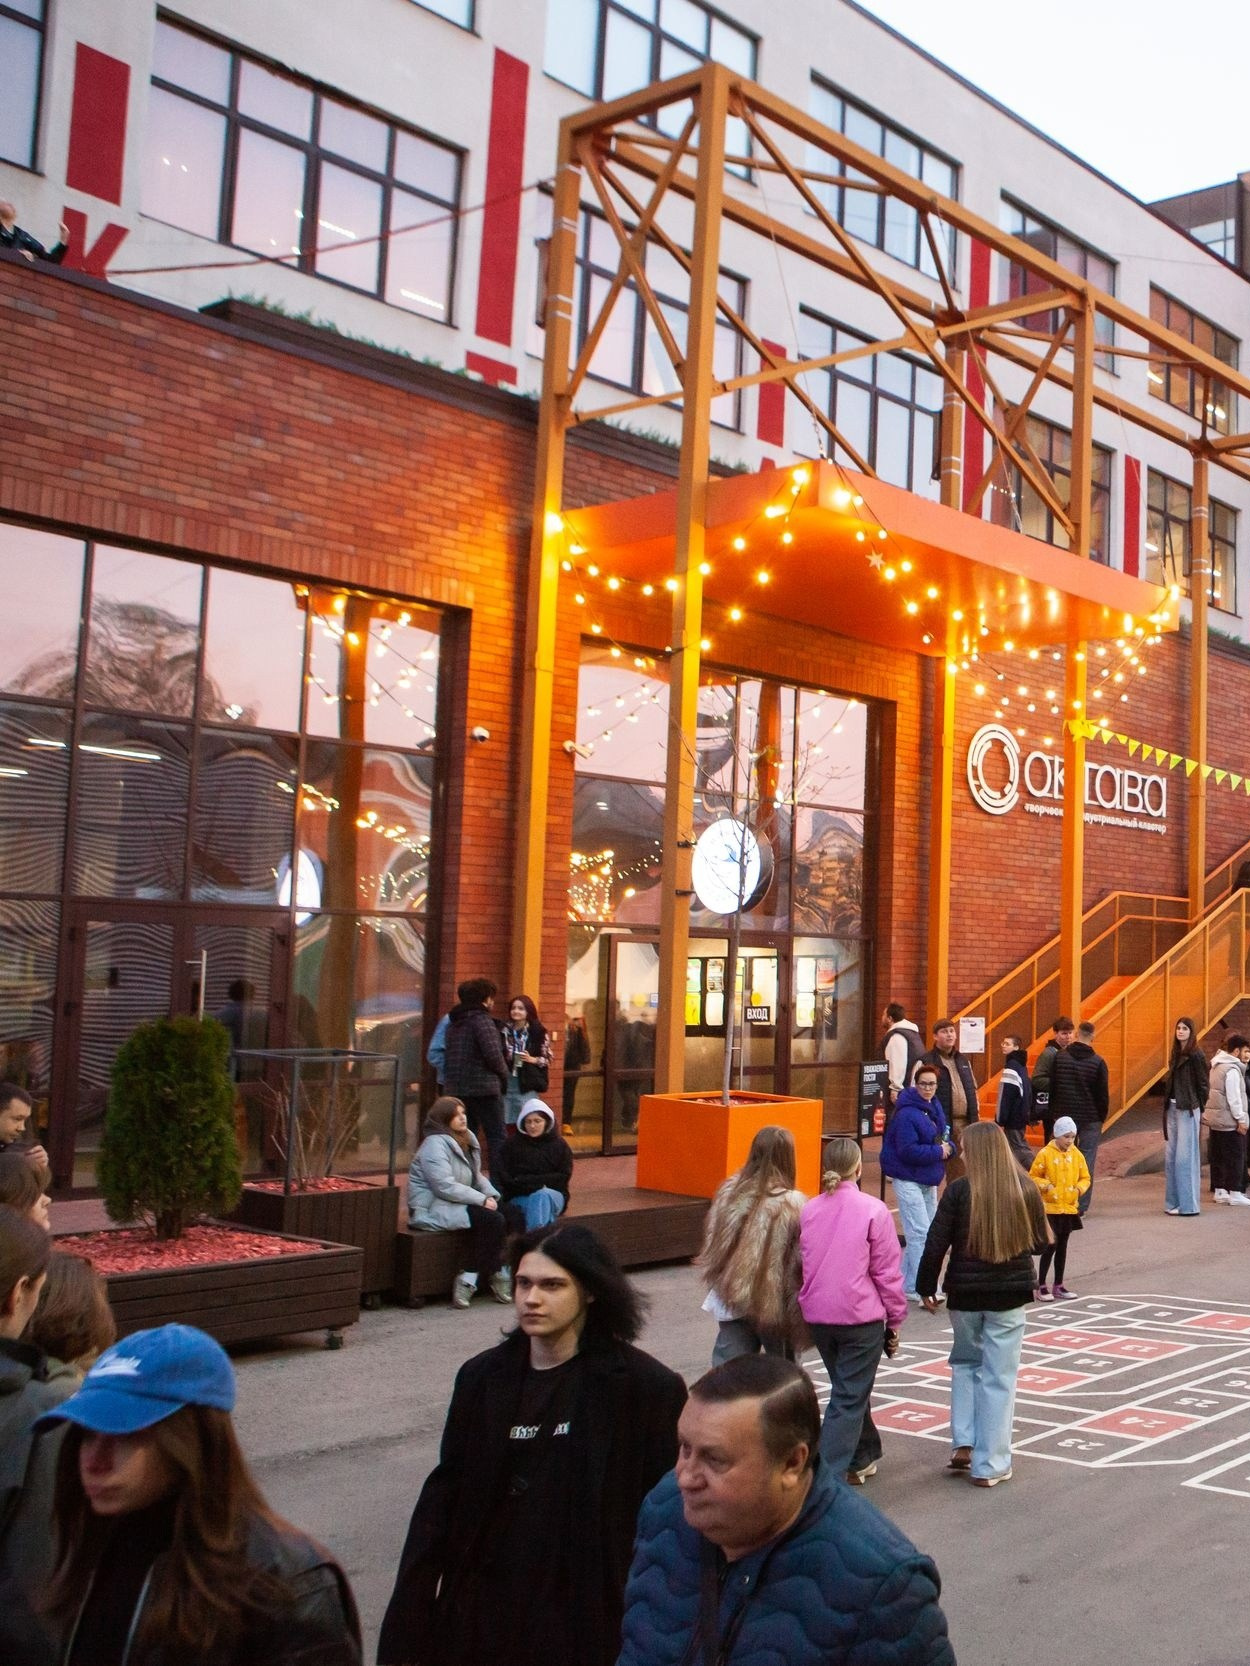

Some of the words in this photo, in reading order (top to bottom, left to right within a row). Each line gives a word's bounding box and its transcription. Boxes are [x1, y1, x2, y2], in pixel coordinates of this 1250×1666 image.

[747, 1008, 768, 1021] ВХОД
[1053, 1335, 1090, 1343] 12
[1073, 1359, 1113, 1367] 14
[1018, 1375, 1057, 1384] 15
[1174, 1398, 1219, 1408] 25
[1120, 1416, 1166, 1428] 24
[1057, 1438, 1105, 1450] 23
